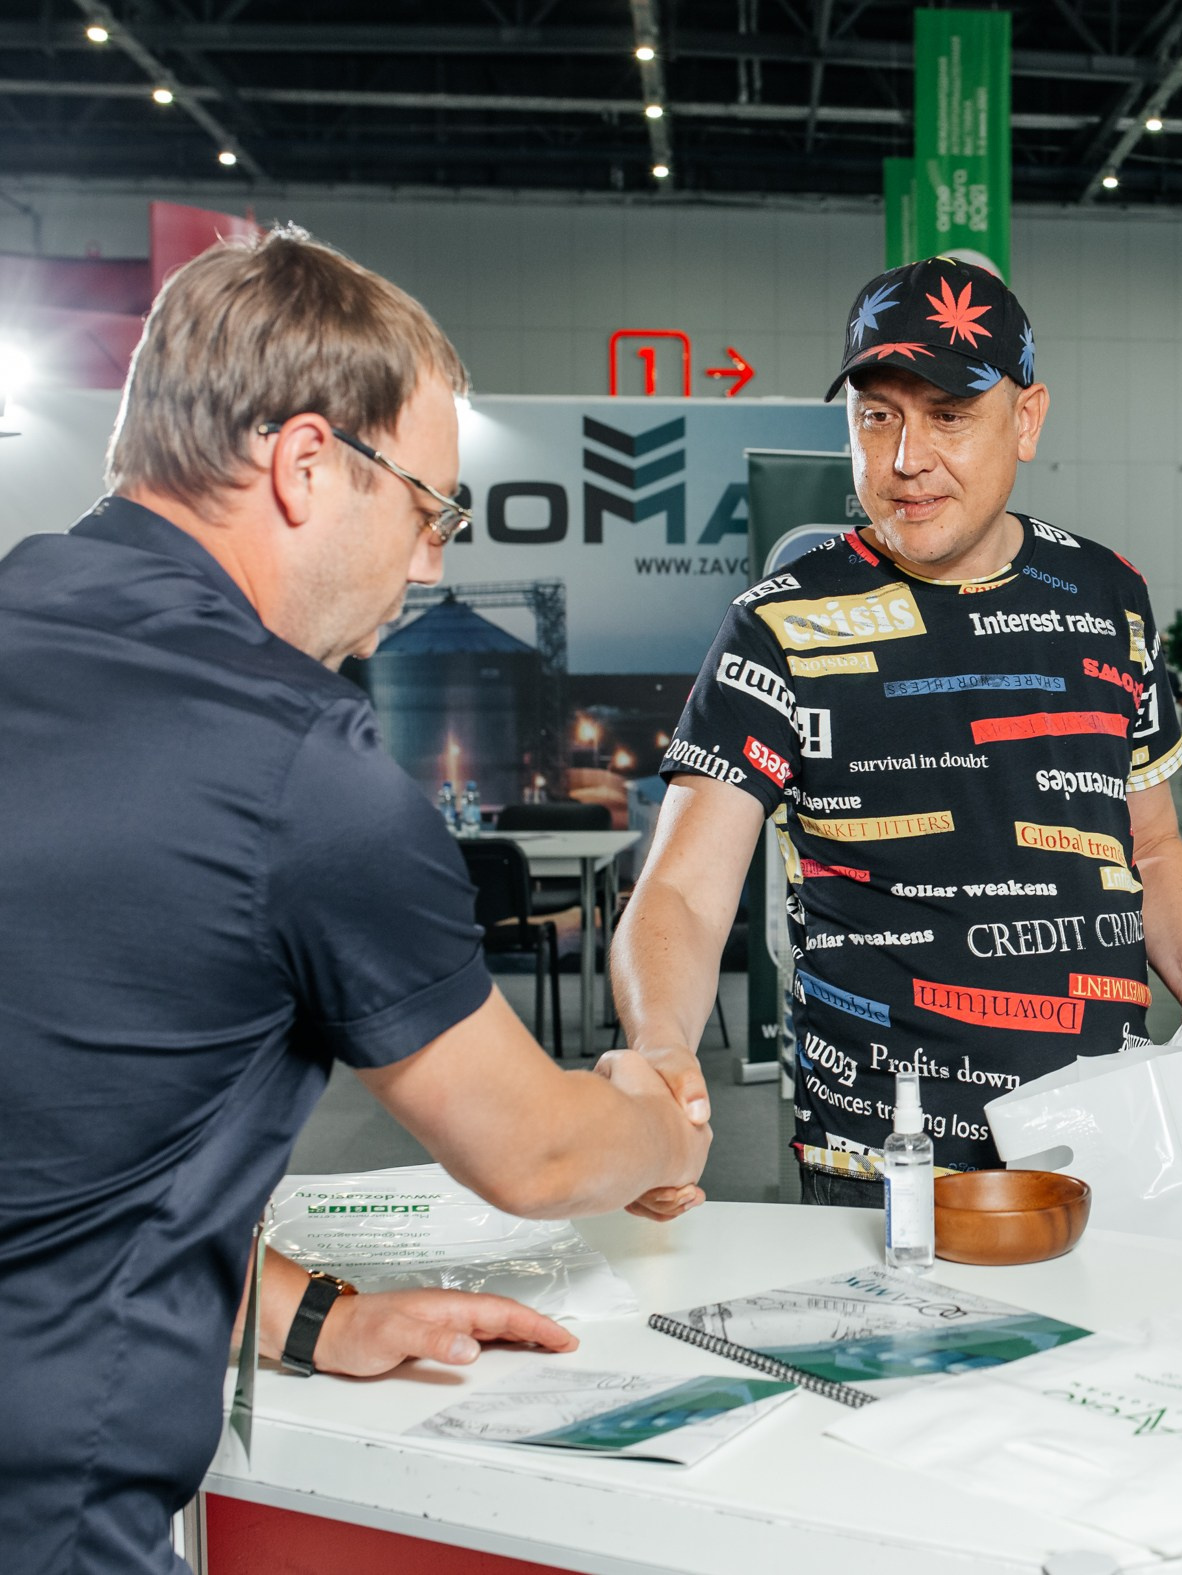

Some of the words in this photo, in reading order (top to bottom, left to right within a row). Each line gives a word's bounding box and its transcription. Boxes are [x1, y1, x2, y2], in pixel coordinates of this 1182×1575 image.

[637, 346, 656, 396] 1
[738, 576, 796, 607] risk
[1022, 565, 1078, 594] endorse
[783, 595, 915, 645] crisis
[968, 609, 1064, 636] Interest
[1065, 612, 1117, 637] rates
[665, 728, 748, 786] ooming
[849, 753, 917, 773] survival
[920, 755, 937, 769] in
[940, 752, 990, 769] doubt
[876, 814, 950, 838] JITTERS
[1021, 825, 1083, 853] Global
[890, 883, 958, 898] dollar
[962, 880, 1058, 897] weakens
[848, 929, 935, 946] weakens
[967, 915, 1086, 958] CREDIT
[810, 980, 888, 1023] tumble
[918, 985, 1080, 1030] Downturn
[869, 1042, 950, 1079] Profits
[956, 1055, 1021, 1090] down
[952, 1114, 989, 1141] loss
